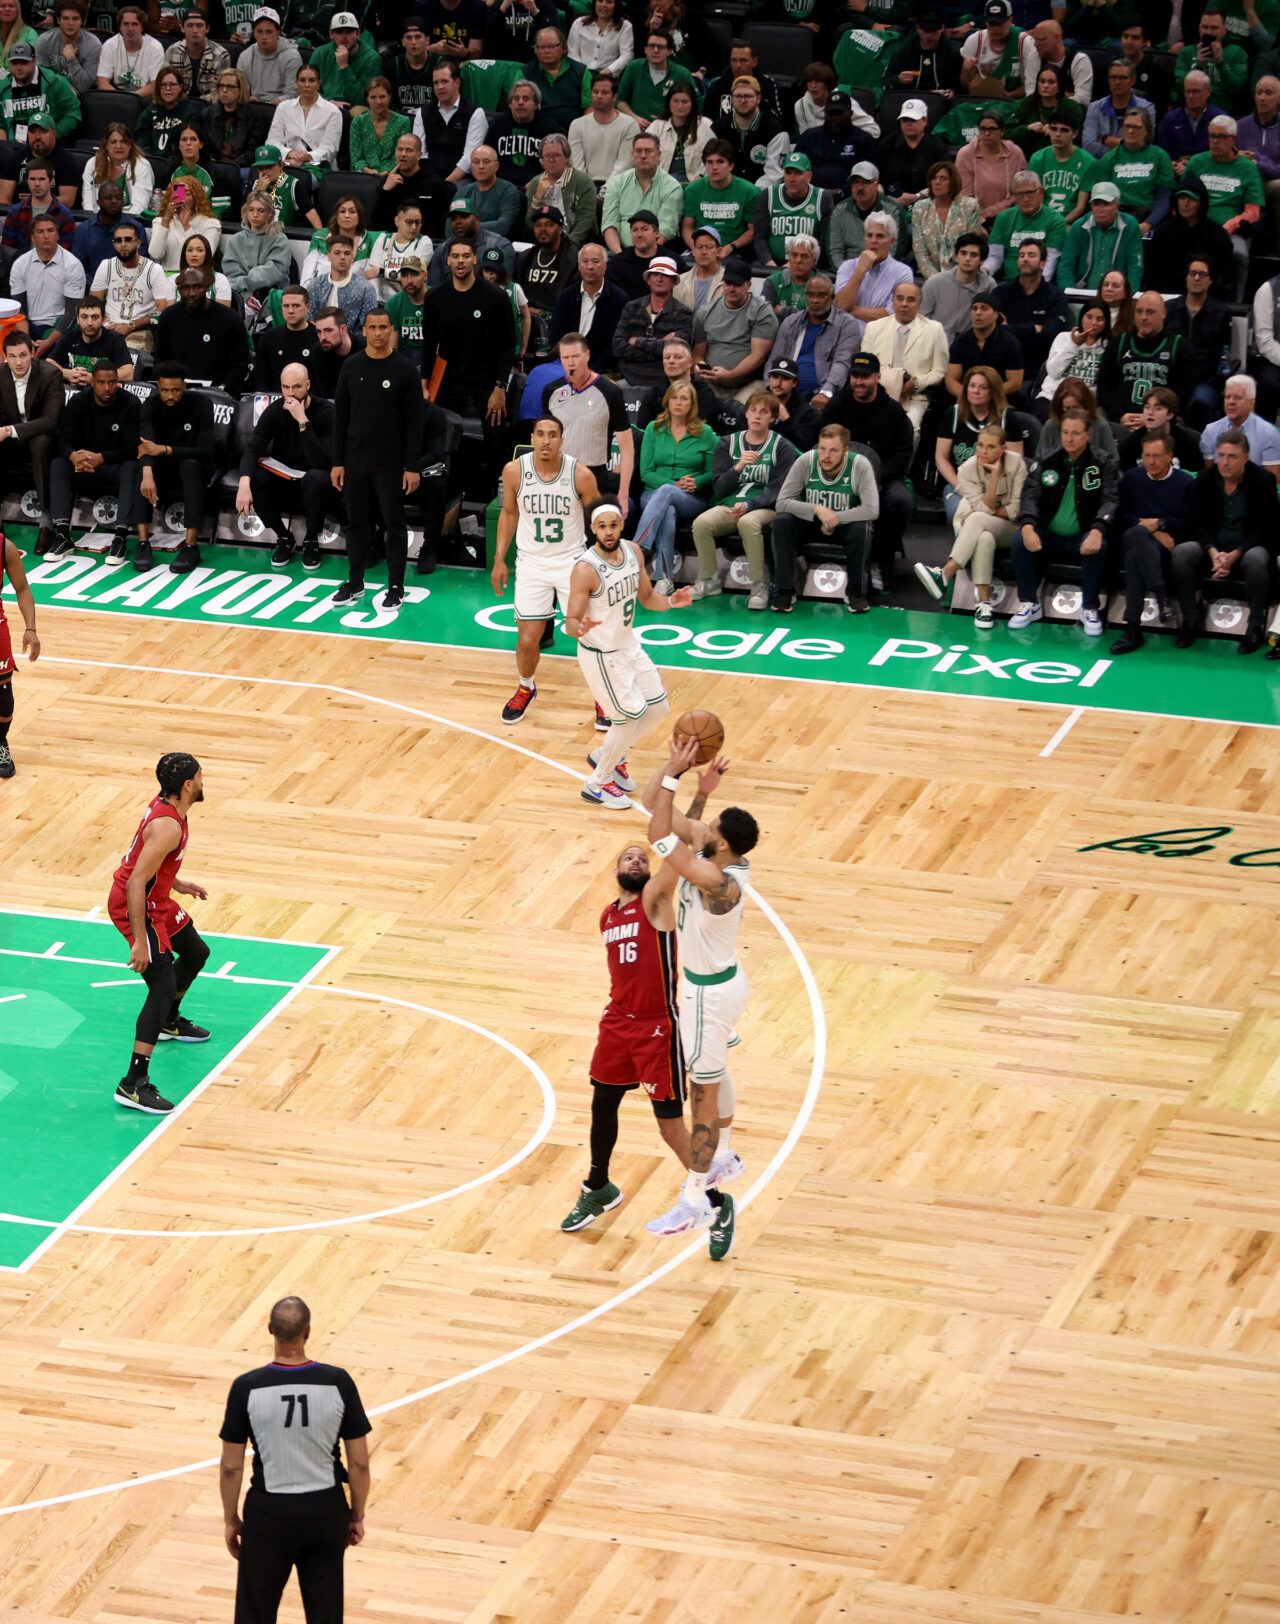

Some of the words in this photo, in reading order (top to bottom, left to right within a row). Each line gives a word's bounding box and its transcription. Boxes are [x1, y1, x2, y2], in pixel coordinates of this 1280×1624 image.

[498, 135, 540, 157] CELTICS
[1042, 170, 1079, 192] CELTICS
[702, 210, 736, 219] BUSINESS
[771, 216, 815, 236] BOSTON
[528, 269, 559, 284] 1977
[401, 326, 424, 340] PRI
[1122, 362, 1168, 385] CELTICS
[1131, 379, 1153, 405] 0
[1082, 465, 1101, 492] C
[523, 494, 571, 516] CELTICS
[806, 487, 850, 511] BOSTON
[533, 517, 564, 543] 13
[2, 555, 431, 629] PLAYOFFS
[622, 600, 634, 627] 9
[474, 603, 845, 661] Gogle
[867, 637, 1113, 688] Pixel
[602, 921, 640, 945] MIAMI
[618, 941, 638, 964] 16
[280, 1394, 309, 1428] 71
